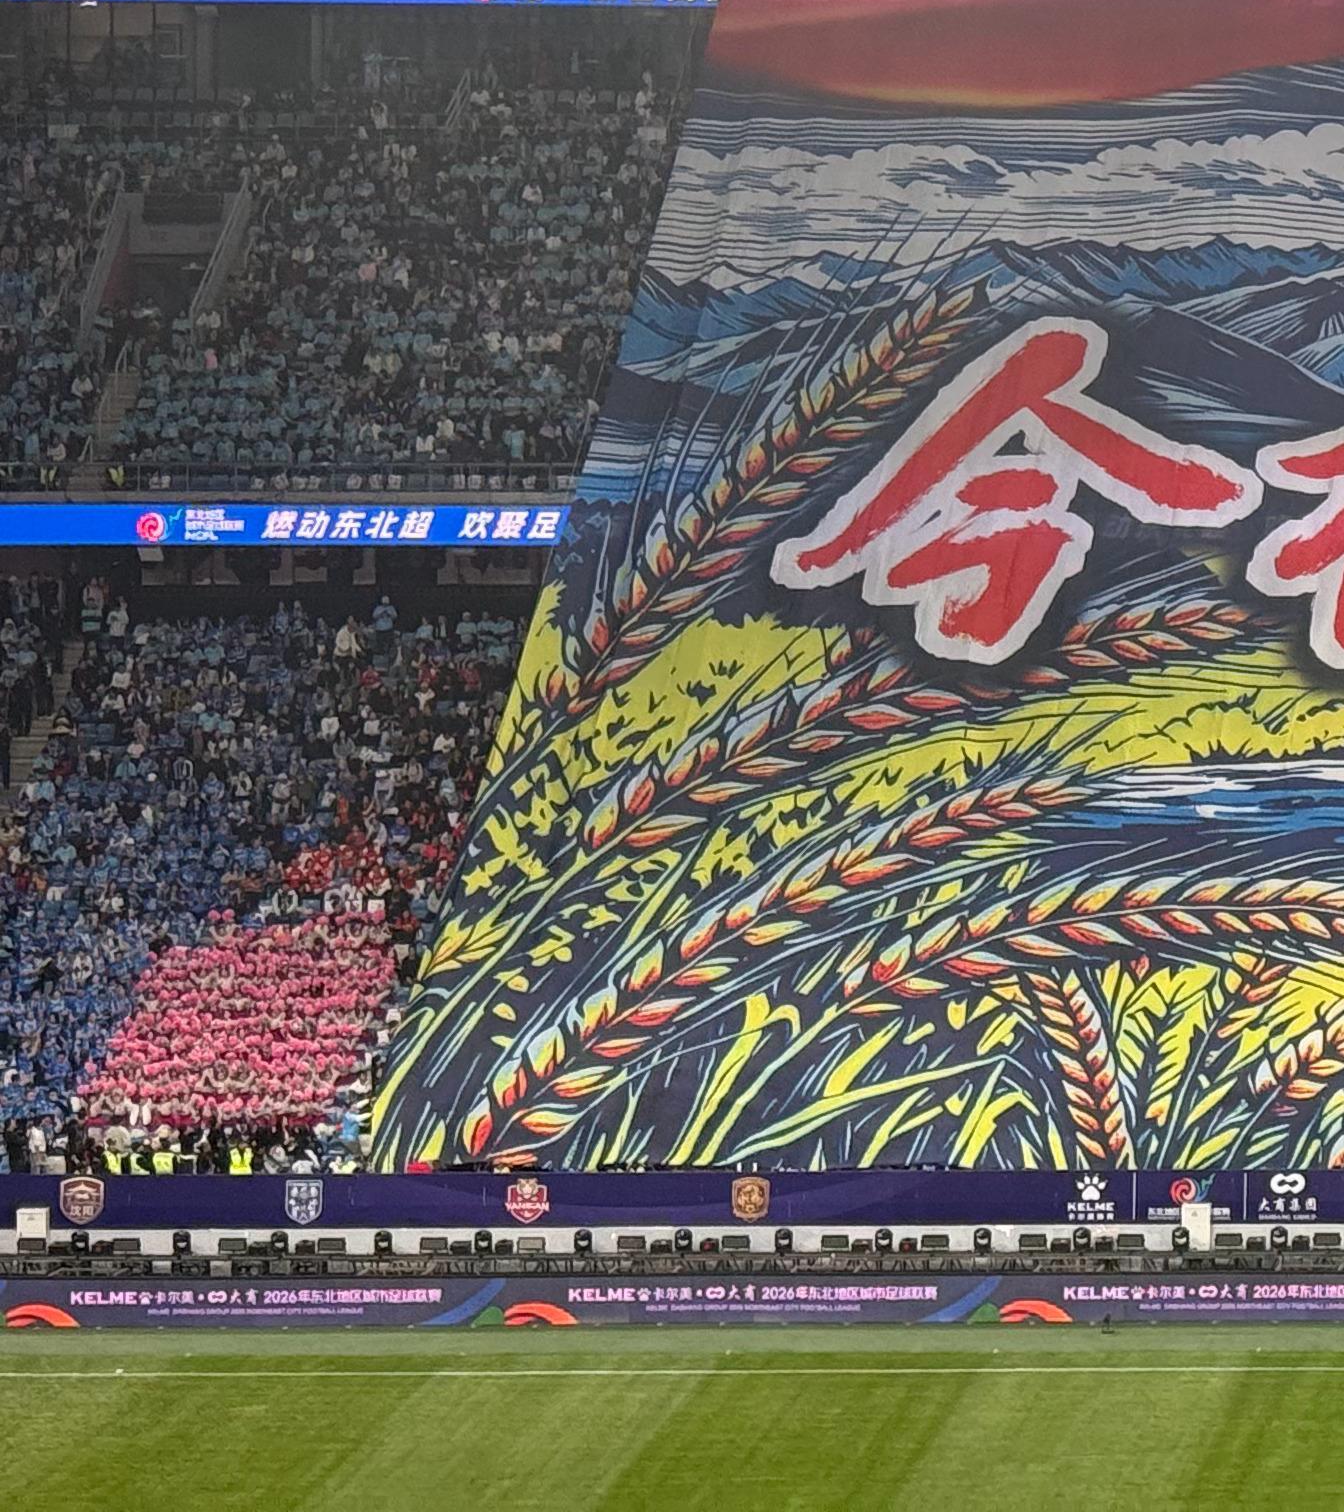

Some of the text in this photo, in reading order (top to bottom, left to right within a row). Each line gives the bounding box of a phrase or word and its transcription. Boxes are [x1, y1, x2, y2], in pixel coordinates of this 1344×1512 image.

[261, 510, 560, 539] 燃动东北超 欢聚足
[1067, 1202, 1115, 1212] KELME
[70, 1291, 137, 1305] KELME
[568, 1288, 635, 1302] KELME
[1063, 1286, 1130, 1300] KELME
